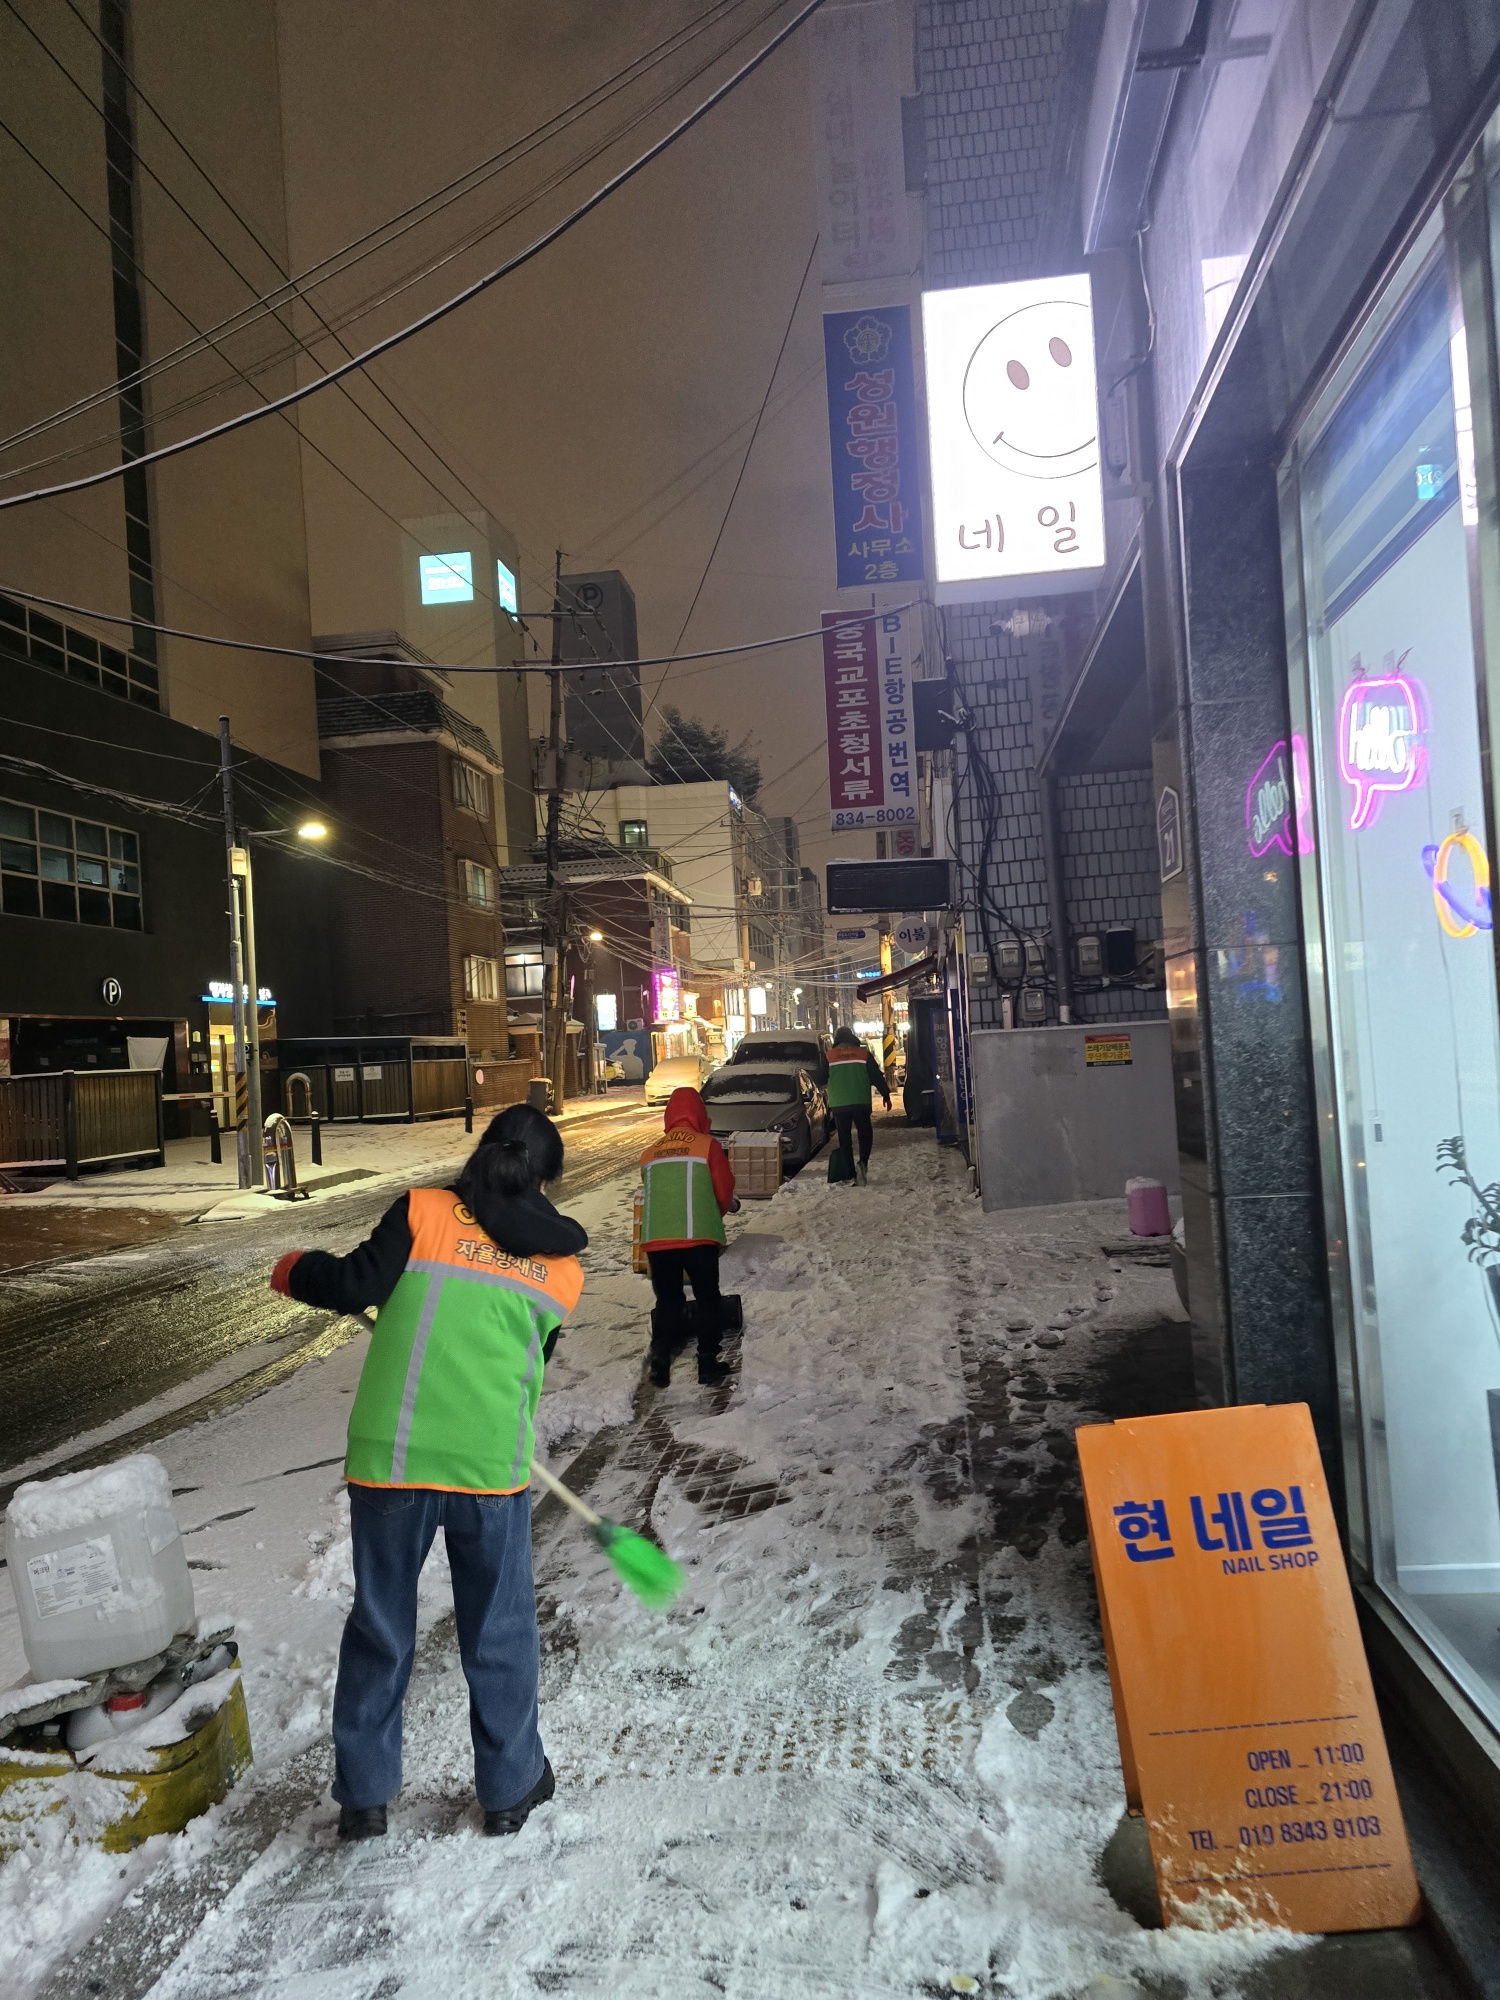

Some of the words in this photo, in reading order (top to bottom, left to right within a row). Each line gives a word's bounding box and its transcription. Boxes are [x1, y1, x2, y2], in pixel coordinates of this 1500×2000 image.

[847, 536, 915, 560] 사무소
[865, 560, 899, 581] 2층
[833, 618, 875, 802] 중국교포초청서류
[835, 806, 916, 827] 834-8002
[1164, 828, 1176, 868] 21
[898, 926, 927, 943] 이불
[456, 1239, 548, 1283] 자율방재단
[1112, 1499, 1176, 1563] 현
[1189, 1485, 1315, 1553] 네일
[1221, 1556, 1267, 1575] NAIL
[1267, 1550, 1320, 1571] SHOP
[1246, 1748, 1292, 1772] OPEN
[1313, 1742, 1365, 1766] 11:00
[1245, 1784, 1300, 1809] CLOSE
[1319, 1778, 1374, 1803] 21:00
[1238, 1824, 1276, 1848] 010
[1278, 1818, 1329, 1844] 8343
[1332, 1814, 1382, 1840] 9103
